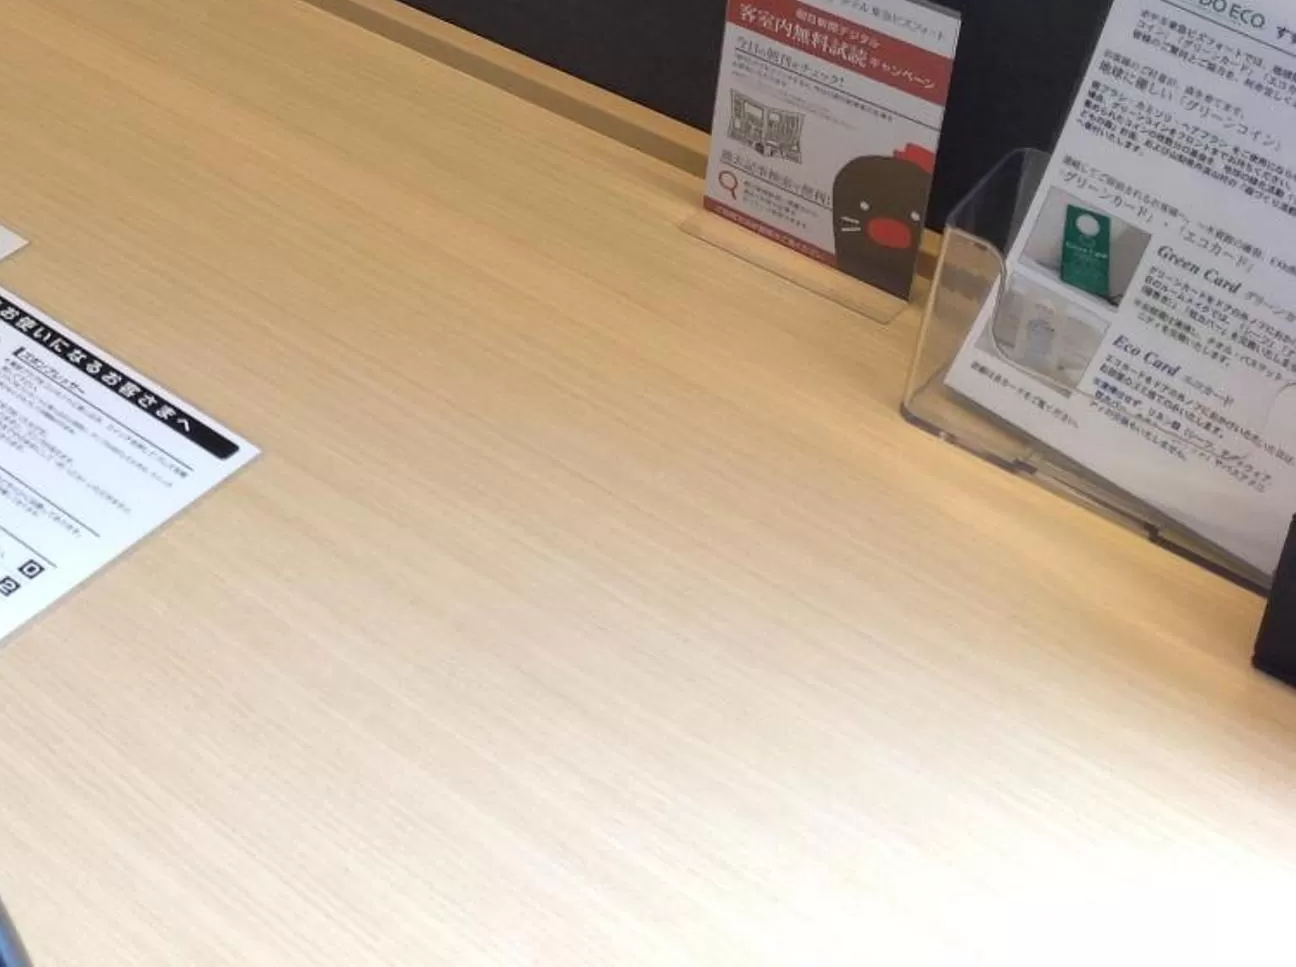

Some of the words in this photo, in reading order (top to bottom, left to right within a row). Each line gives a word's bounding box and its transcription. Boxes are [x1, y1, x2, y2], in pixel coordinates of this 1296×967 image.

[1229, 3, 1265, 28] ECO
[1157, 245, 1201, 275] Green
[1203, 267, 1243, 294] Card
[1112, 334, 1141, 356] Eco
[1143, 351, 1181, 377] Card
[19, 561, 42, 577] 0
